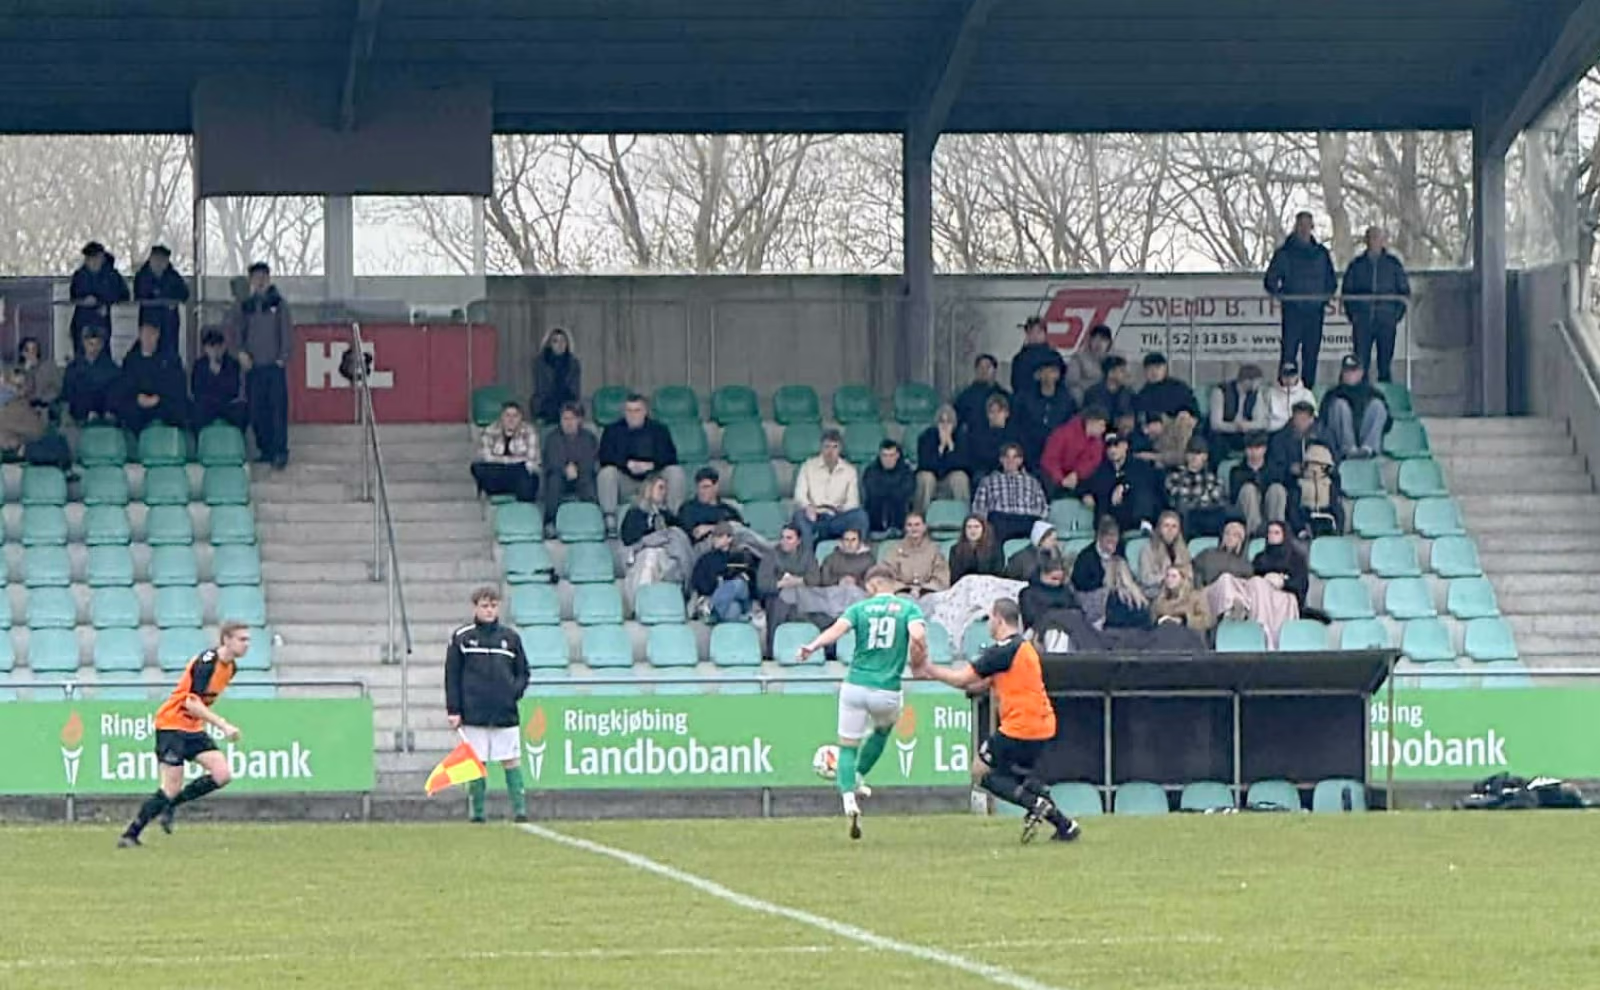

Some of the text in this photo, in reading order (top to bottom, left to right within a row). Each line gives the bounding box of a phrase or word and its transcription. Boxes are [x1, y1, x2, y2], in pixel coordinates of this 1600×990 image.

[1140, 333, 1163, 346] Tlf.
[866, 616, 897, 650] 19
[564, 708, 688, 737] Ringkjøbing
[564, 737, 774, 775] Landbobank
